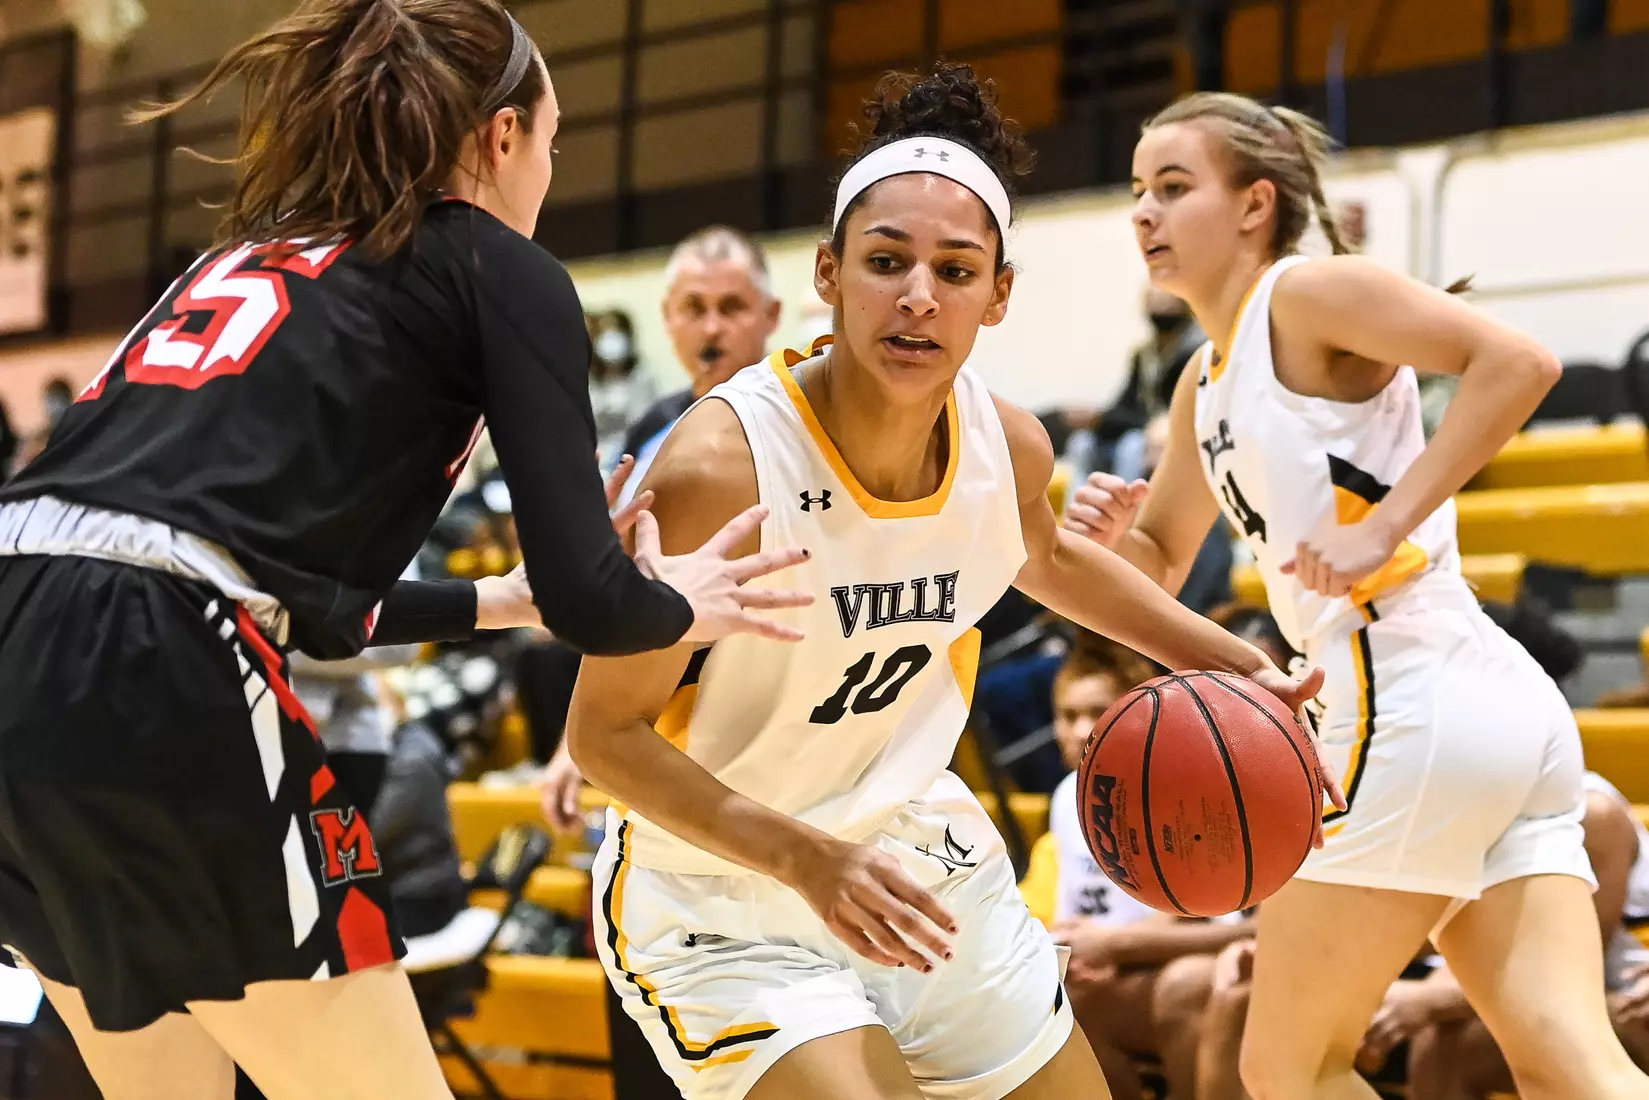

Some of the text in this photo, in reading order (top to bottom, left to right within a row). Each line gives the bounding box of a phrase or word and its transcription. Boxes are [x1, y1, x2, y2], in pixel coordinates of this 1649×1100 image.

[831, 570, 960, 638] VILLE
[809, 644, 932, 724] 10
[309, 805, 383, 888] M
[1092, 774, 1139, 892] NCAA
